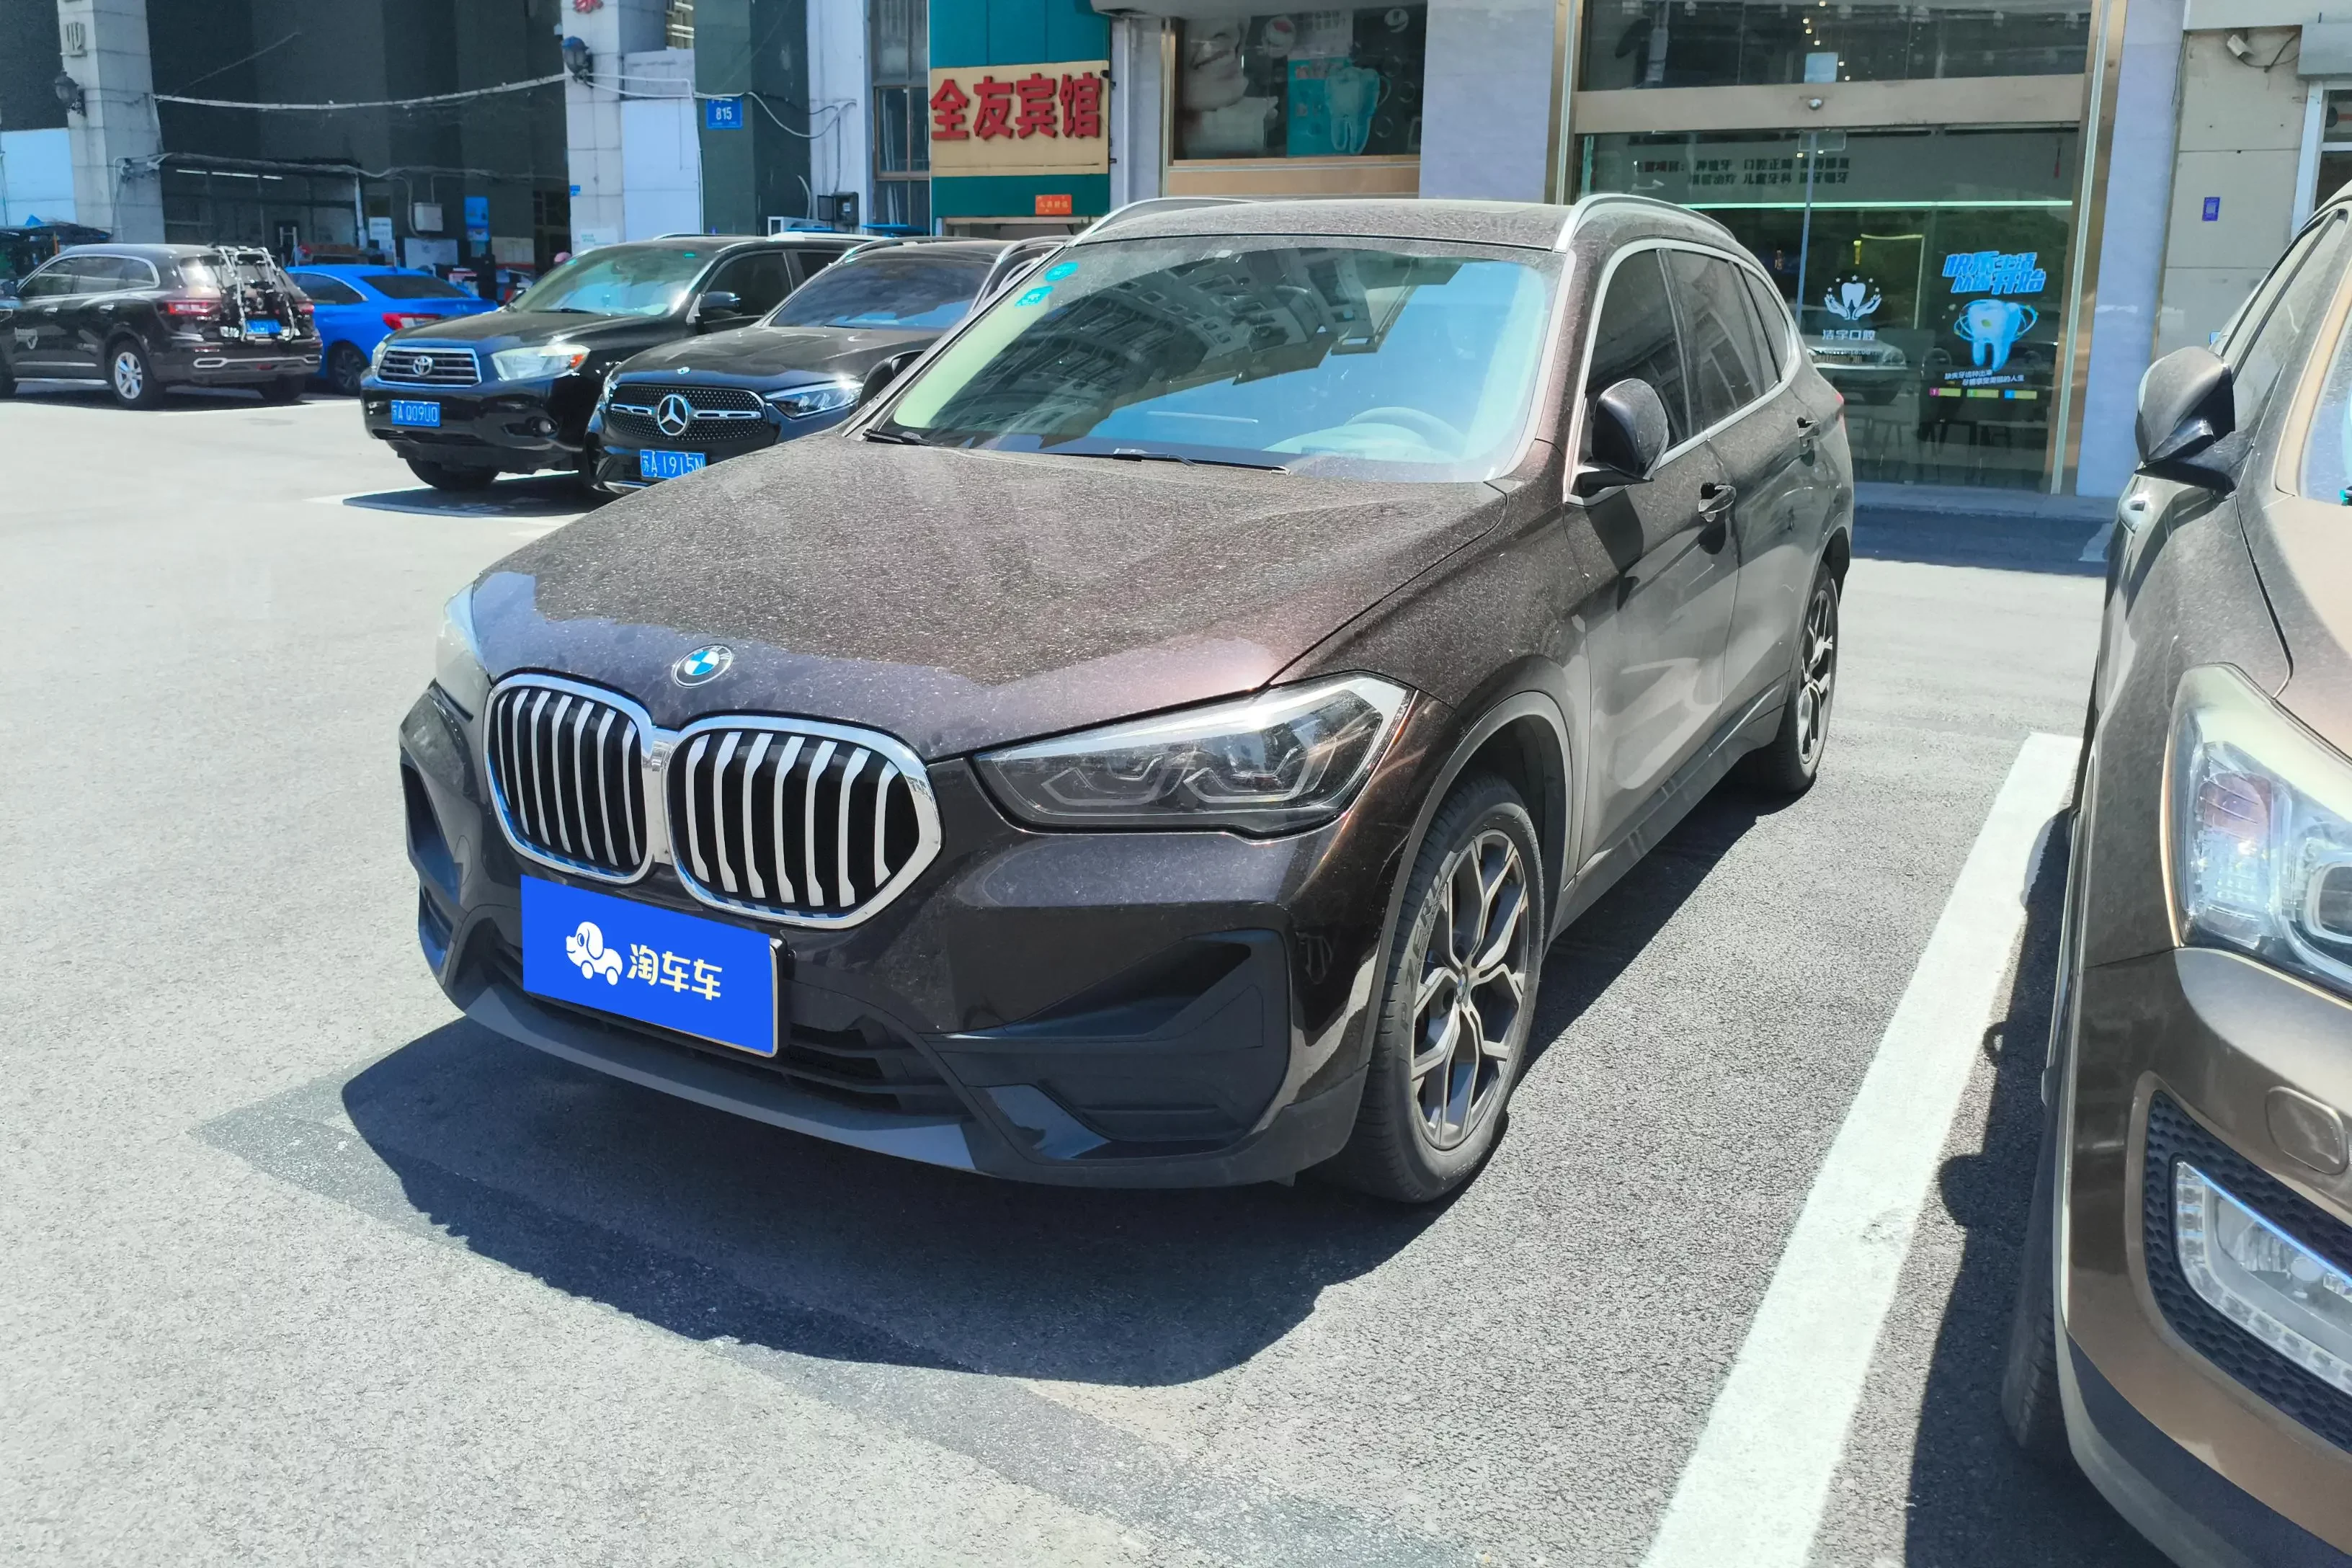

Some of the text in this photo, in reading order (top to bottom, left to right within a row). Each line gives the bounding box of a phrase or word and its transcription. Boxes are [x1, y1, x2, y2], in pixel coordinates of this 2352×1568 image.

[716, 107, 732, 121] 815
[930, 72, 1102, 141] 全友宾馆
